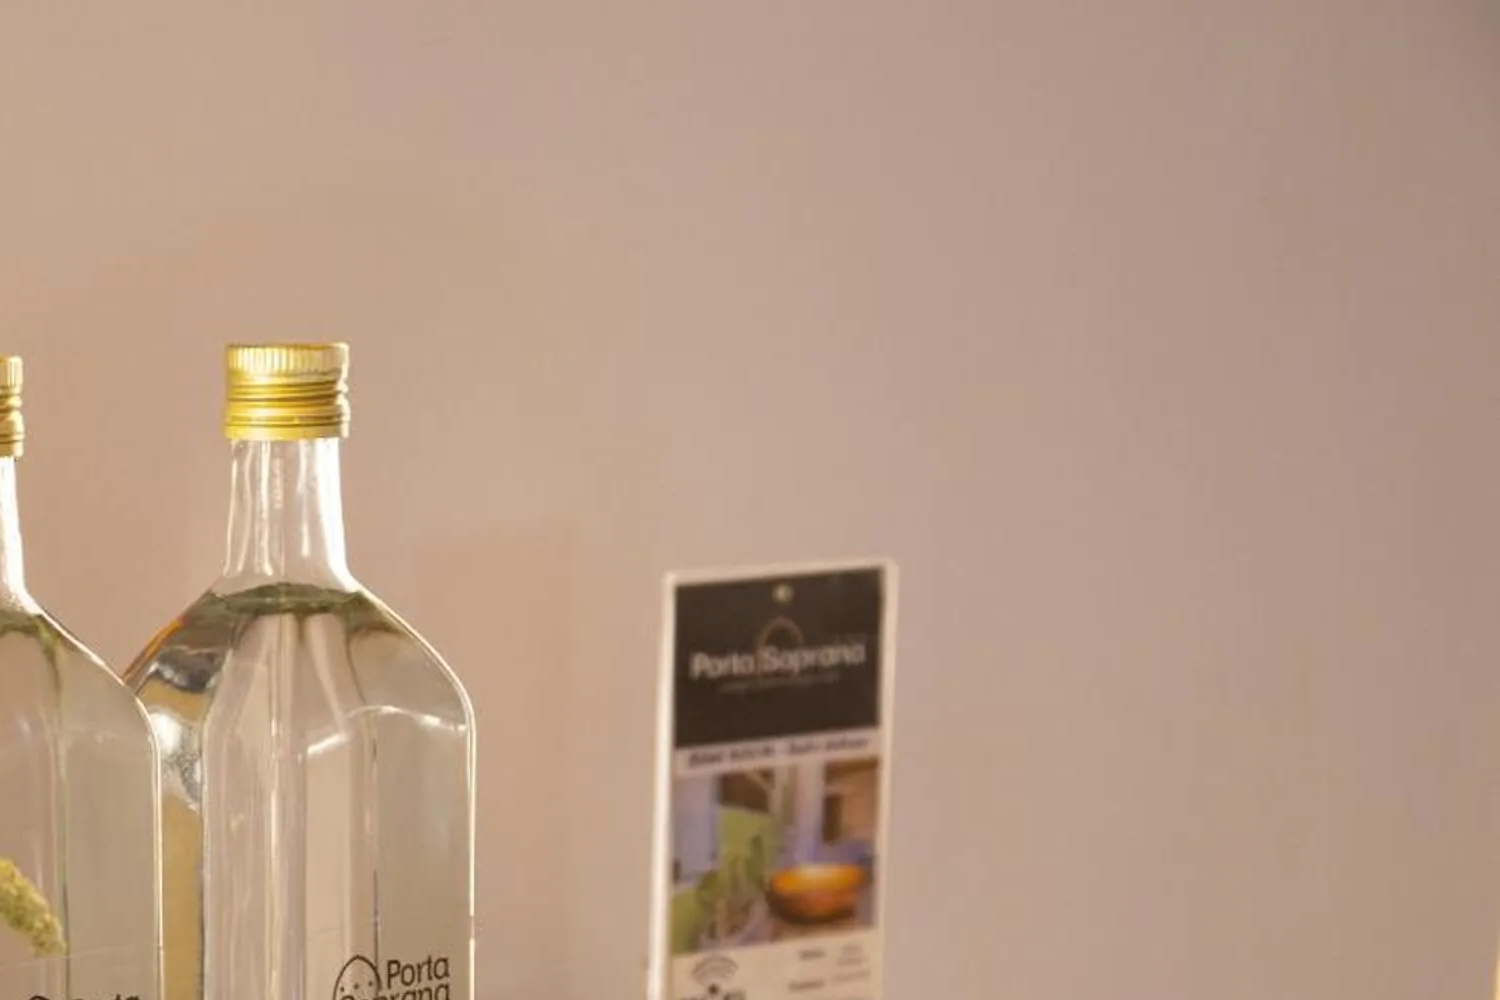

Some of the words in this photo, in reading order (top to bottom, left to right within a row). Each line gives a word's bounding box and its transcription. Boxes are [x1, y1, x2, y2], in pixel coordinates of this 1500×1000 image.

[690, 651, 755, 681] Porta
[758, 644, 866, 674] Soprana
[387, 955, 450, 990] Porta
